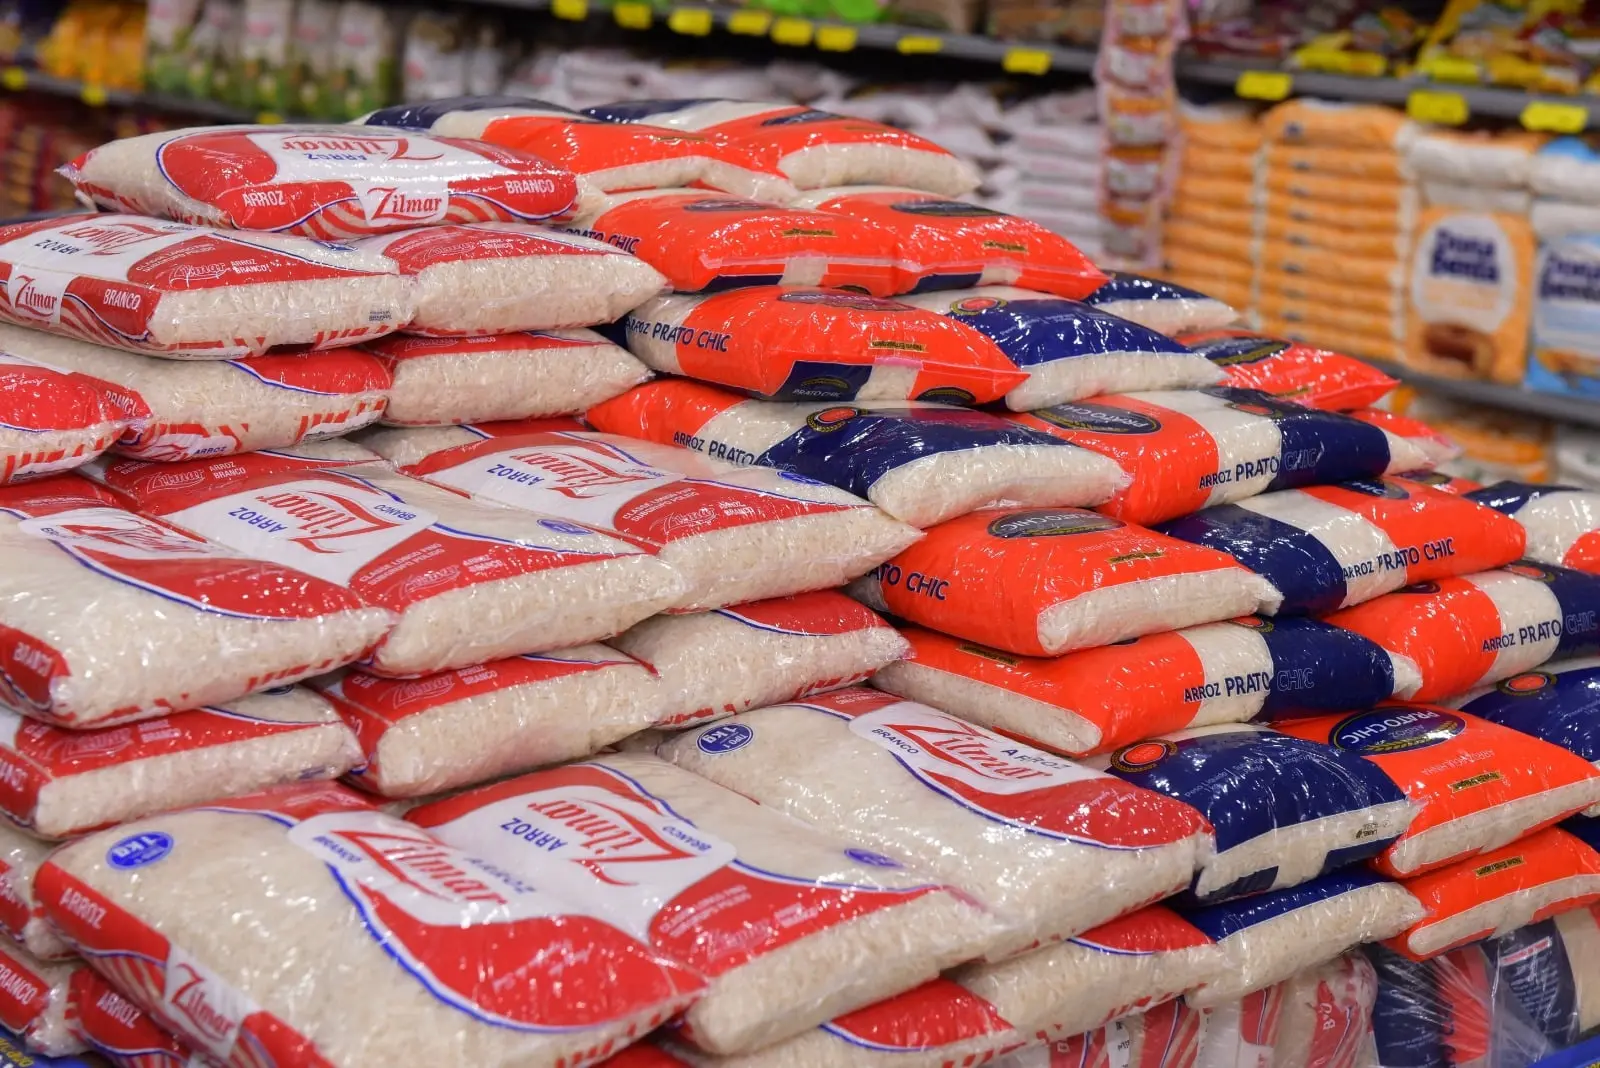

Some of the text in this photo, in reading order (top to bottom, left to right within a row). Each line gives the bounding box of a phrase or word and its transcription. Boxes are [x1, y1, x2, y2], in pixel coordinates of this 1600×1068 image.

[243, 189, 286, 207] ARROZ
[506, 179, 554, 196] BRANCO
[367, 187, 442, 220] Zilmar
[15, 275, 57, 317] Zilmar
[103, 288, 140, 310] BRANCO
[652, 323, 694, 345] PRATO
[697, 331, 730, 352] CHIC
[674, 431, 705, 451] ARROZ
[209, 461, 235, 471] ARROZ
[213, 467, 246, 479] BRANCO
[487, 464, 545, 486] ARROZ
[1199, 448, 1317, 489] ARROZ PRATO CHIC
[146, 470, 205, 494] Zilmar
[229, 507, 288, 533] ARROZ
[373, 504, 416, 521] BRANCO
[1342, 538, 1456, 580] ARROZ PRATO CHIC
[906, 572, 948, 600] CHIC
[1482, 610, 1598, 653] ARROZ PRATO CHIC
[462, 671, 498, 685] BRANCO
[1183, 667, 1315, 703] ARROZ PRATO CHIC
[872, 728, 919, 754] BRANCO
[1341, 710, 1441, 744] PRATO CHIC
[882, 714, 1053, 781] Zilmar
[1002, 748, 1073, 770] ARROZ
[500, 816, 568, 852] ARROZ
[528, 797, 698, 887] Zilmar
[662, 826, 712, 852] BRANCO
[59, 887, 108, 928] ARROZ
[96, 991, 142, 1029] ARROZ
[171, 962, 236, 1042] Zilmar
